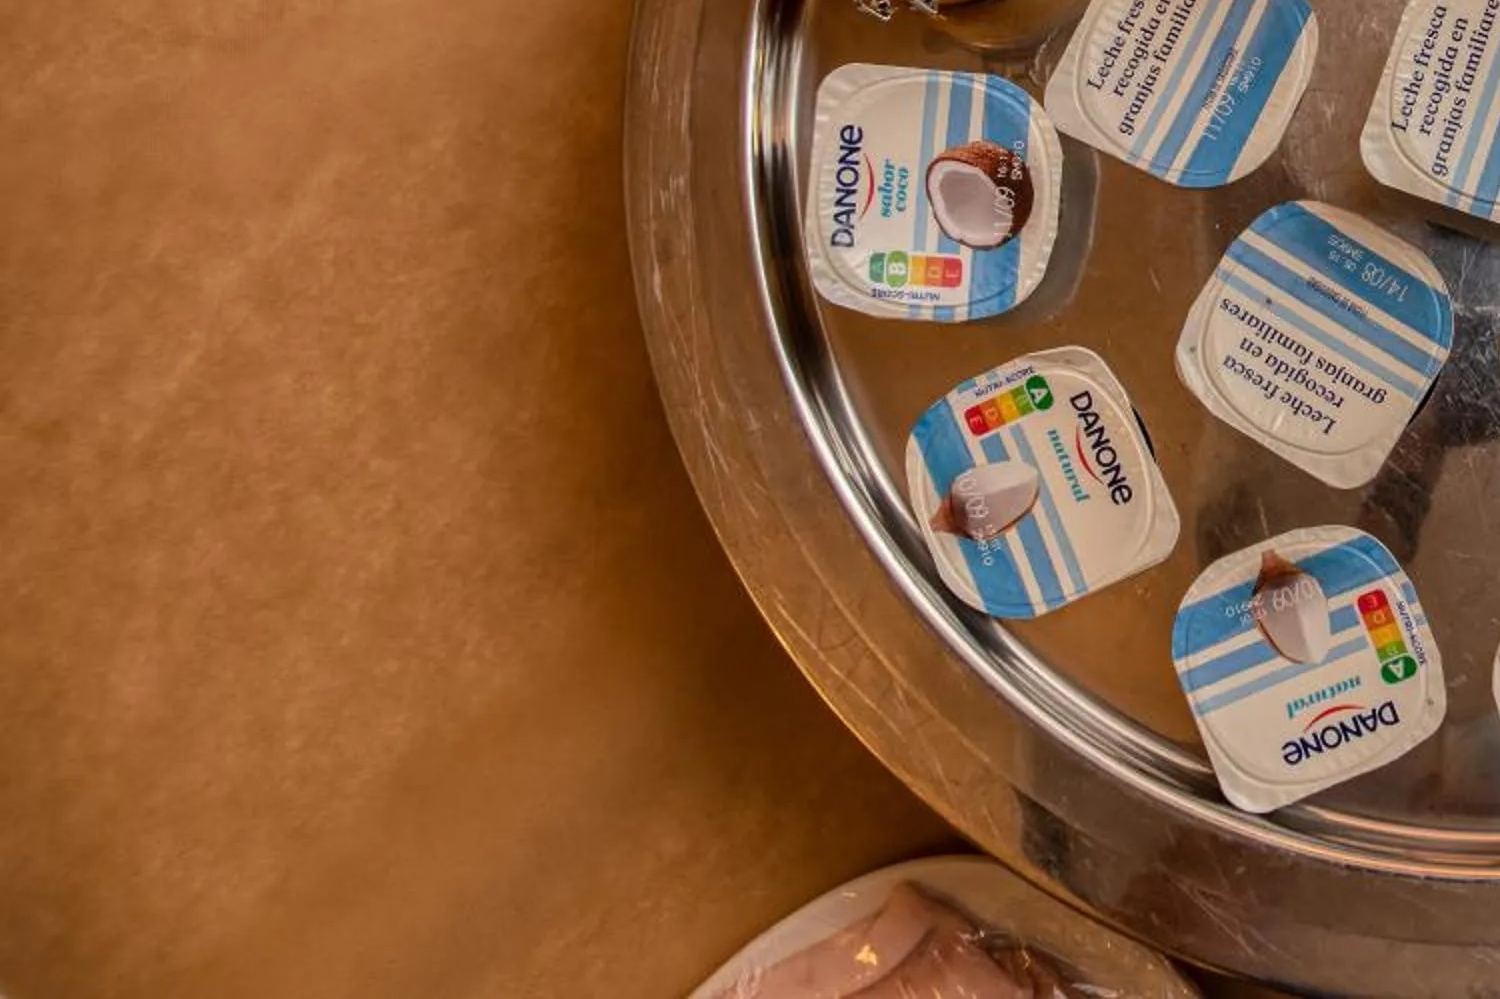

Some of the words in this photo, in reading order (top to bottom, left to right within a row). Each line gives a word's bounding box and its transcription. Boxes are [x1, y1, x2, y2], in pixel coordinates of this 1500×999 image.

[1088, 35, 1124, 91] Leche
[1112, 15, 1159, 97] recogida
[1392, 70, 1424, 133] Leche
[1414, 4, 1448, 67] fresca
[1419, 44, 1458, 136] recogida
[1454, 17, 1468, 42] en
[1119, 64, 1161, 136] granjas
[1432, 99, 1466, 177] granjas
[831, 123, 863, 248] DANONE
[877, 158, 897, 218] sabor
[896, 167, 909, 212] coco
[1362, 264, 1409, 302] 14/08
[1220, 298, 1314, 365] familiares
[1239, 337, 1263, 359] en
[1222, 355, 1280, 400] fresca
[1265, 354, 1345, 409] recogida
[1316, 354, 1388, 405] granjas
[1280, 391, 1337, 435] Leche
[1047, 429, 1091, 503] natural
[1070, 390, 1133, 506] DANONE
[1286, 675, 1362, 719] natural
[1282, 700, 1400, 765] DANONE
